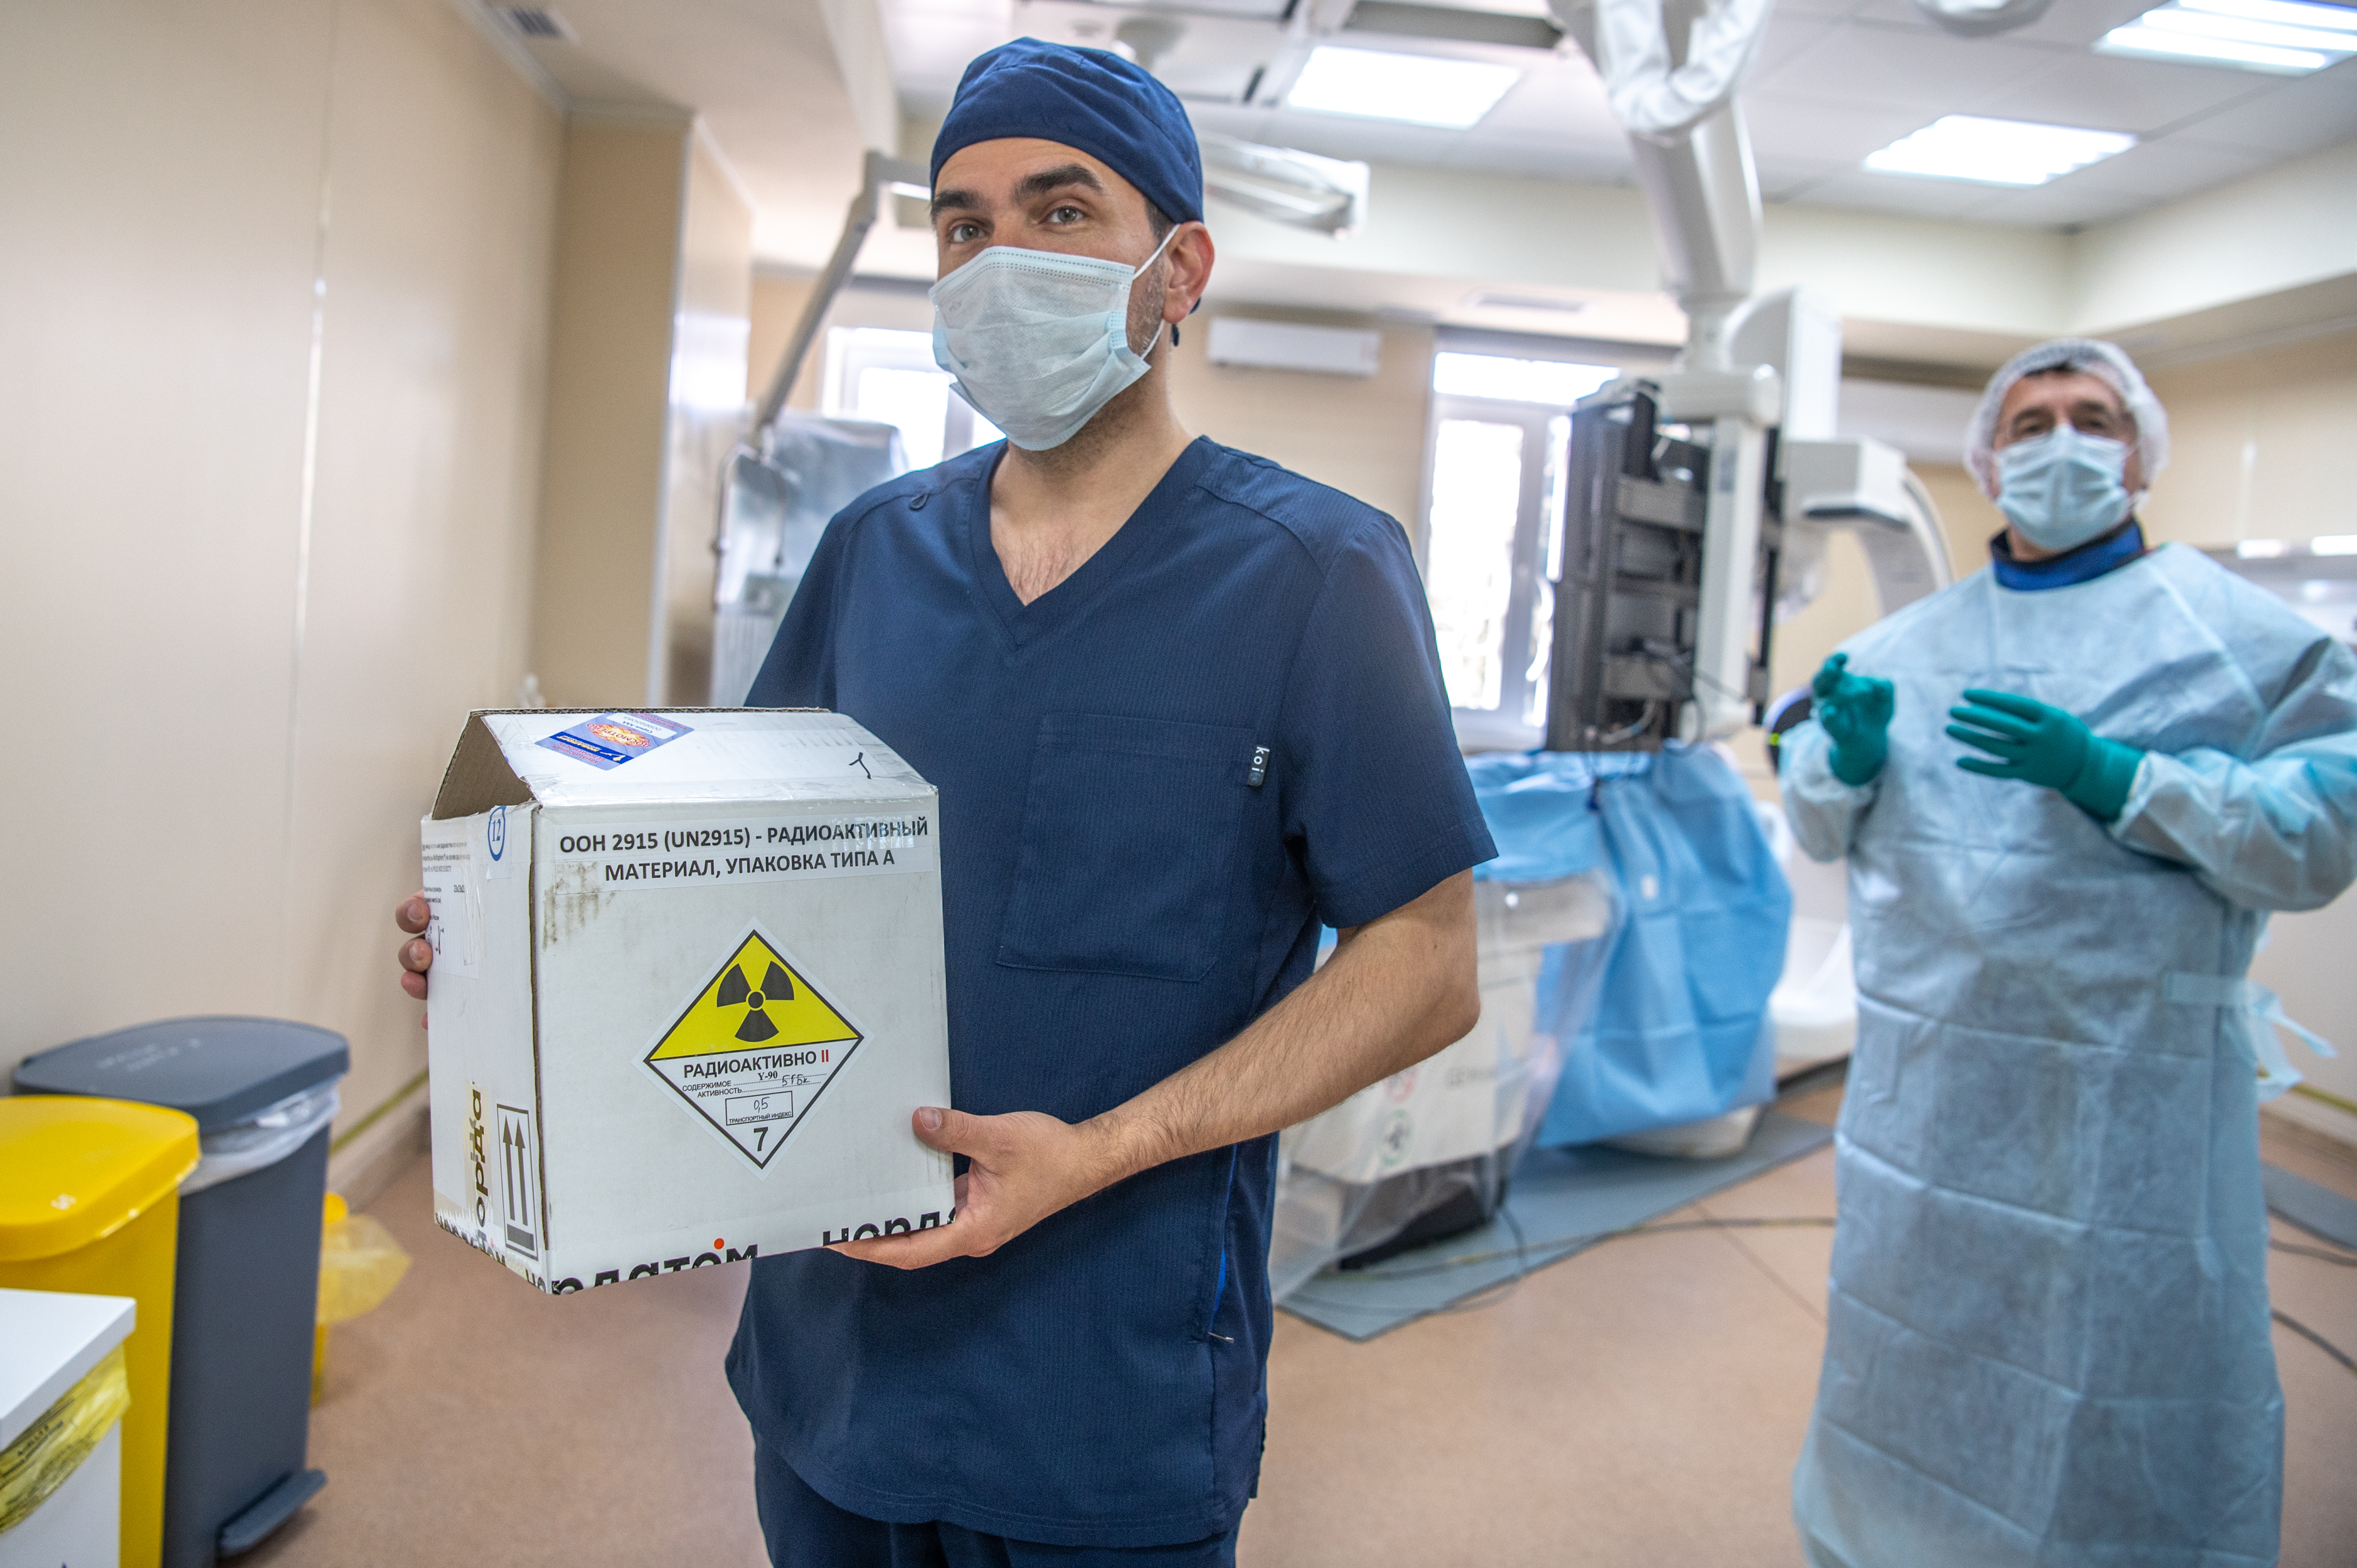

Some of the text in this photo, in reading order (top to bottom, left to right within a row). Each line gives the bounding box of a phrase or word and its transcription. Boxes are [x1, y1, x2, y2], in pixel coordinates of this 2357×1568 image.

[587, 723, 653, 748] ДОСМОТРЕНО
[1252, 746, 1270, 773] koi
[491, 818, 501, 842] 12
[560, 835, 605, 853] ООН
[612, 832, 658, 851] 2915
[664, 828, 751, 852] (UN2915)
[767, 816, 928, 845] РАДИОАКТИВНЫЙ
[605, 849, 895, 882] МАТЕРИАЛ, УПАКОВКА ТИПА А
[683, 1051, 817, 1078] РАДИОАКТИВНО
[758, 1071, 778, 1081] Y-90
[682, 1080, 732, 1092] СОДЕРЖИМОЕ
[697, 1088, 742, 1098] АКТИВНОСТЬ
[753, 1096, 770, 1113] 0,5
[728, 1111, 792, 1124] ТРАНСПОРТНЫЙ ИНДЕКС
[753, 1126, 769, 1152] 7
